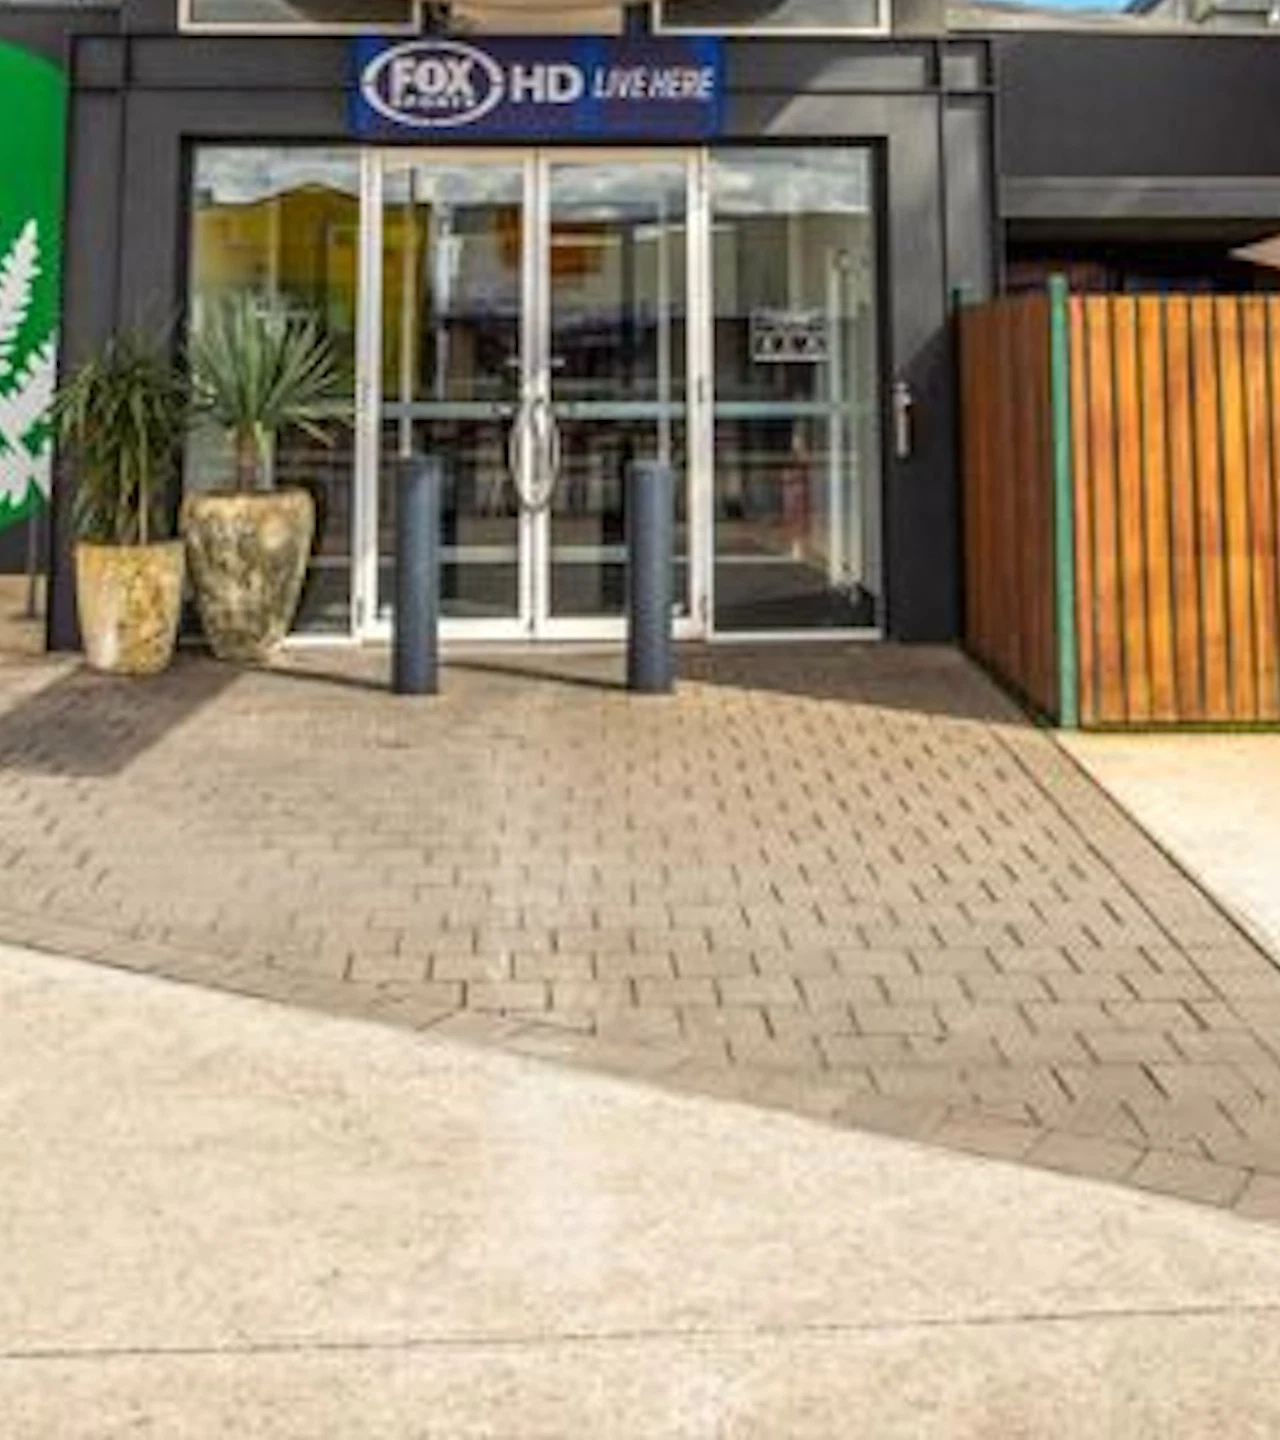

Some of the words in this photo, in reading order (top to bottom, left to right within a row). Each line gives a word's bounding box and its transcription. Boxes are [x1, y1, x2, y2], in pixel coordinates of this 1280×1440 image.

[390, 59, 474, 97] FOX
[510, 64, 584, 104] HD
[591, 67, 648, 100] LIVE
[649, 66, 715, 100] HERE
